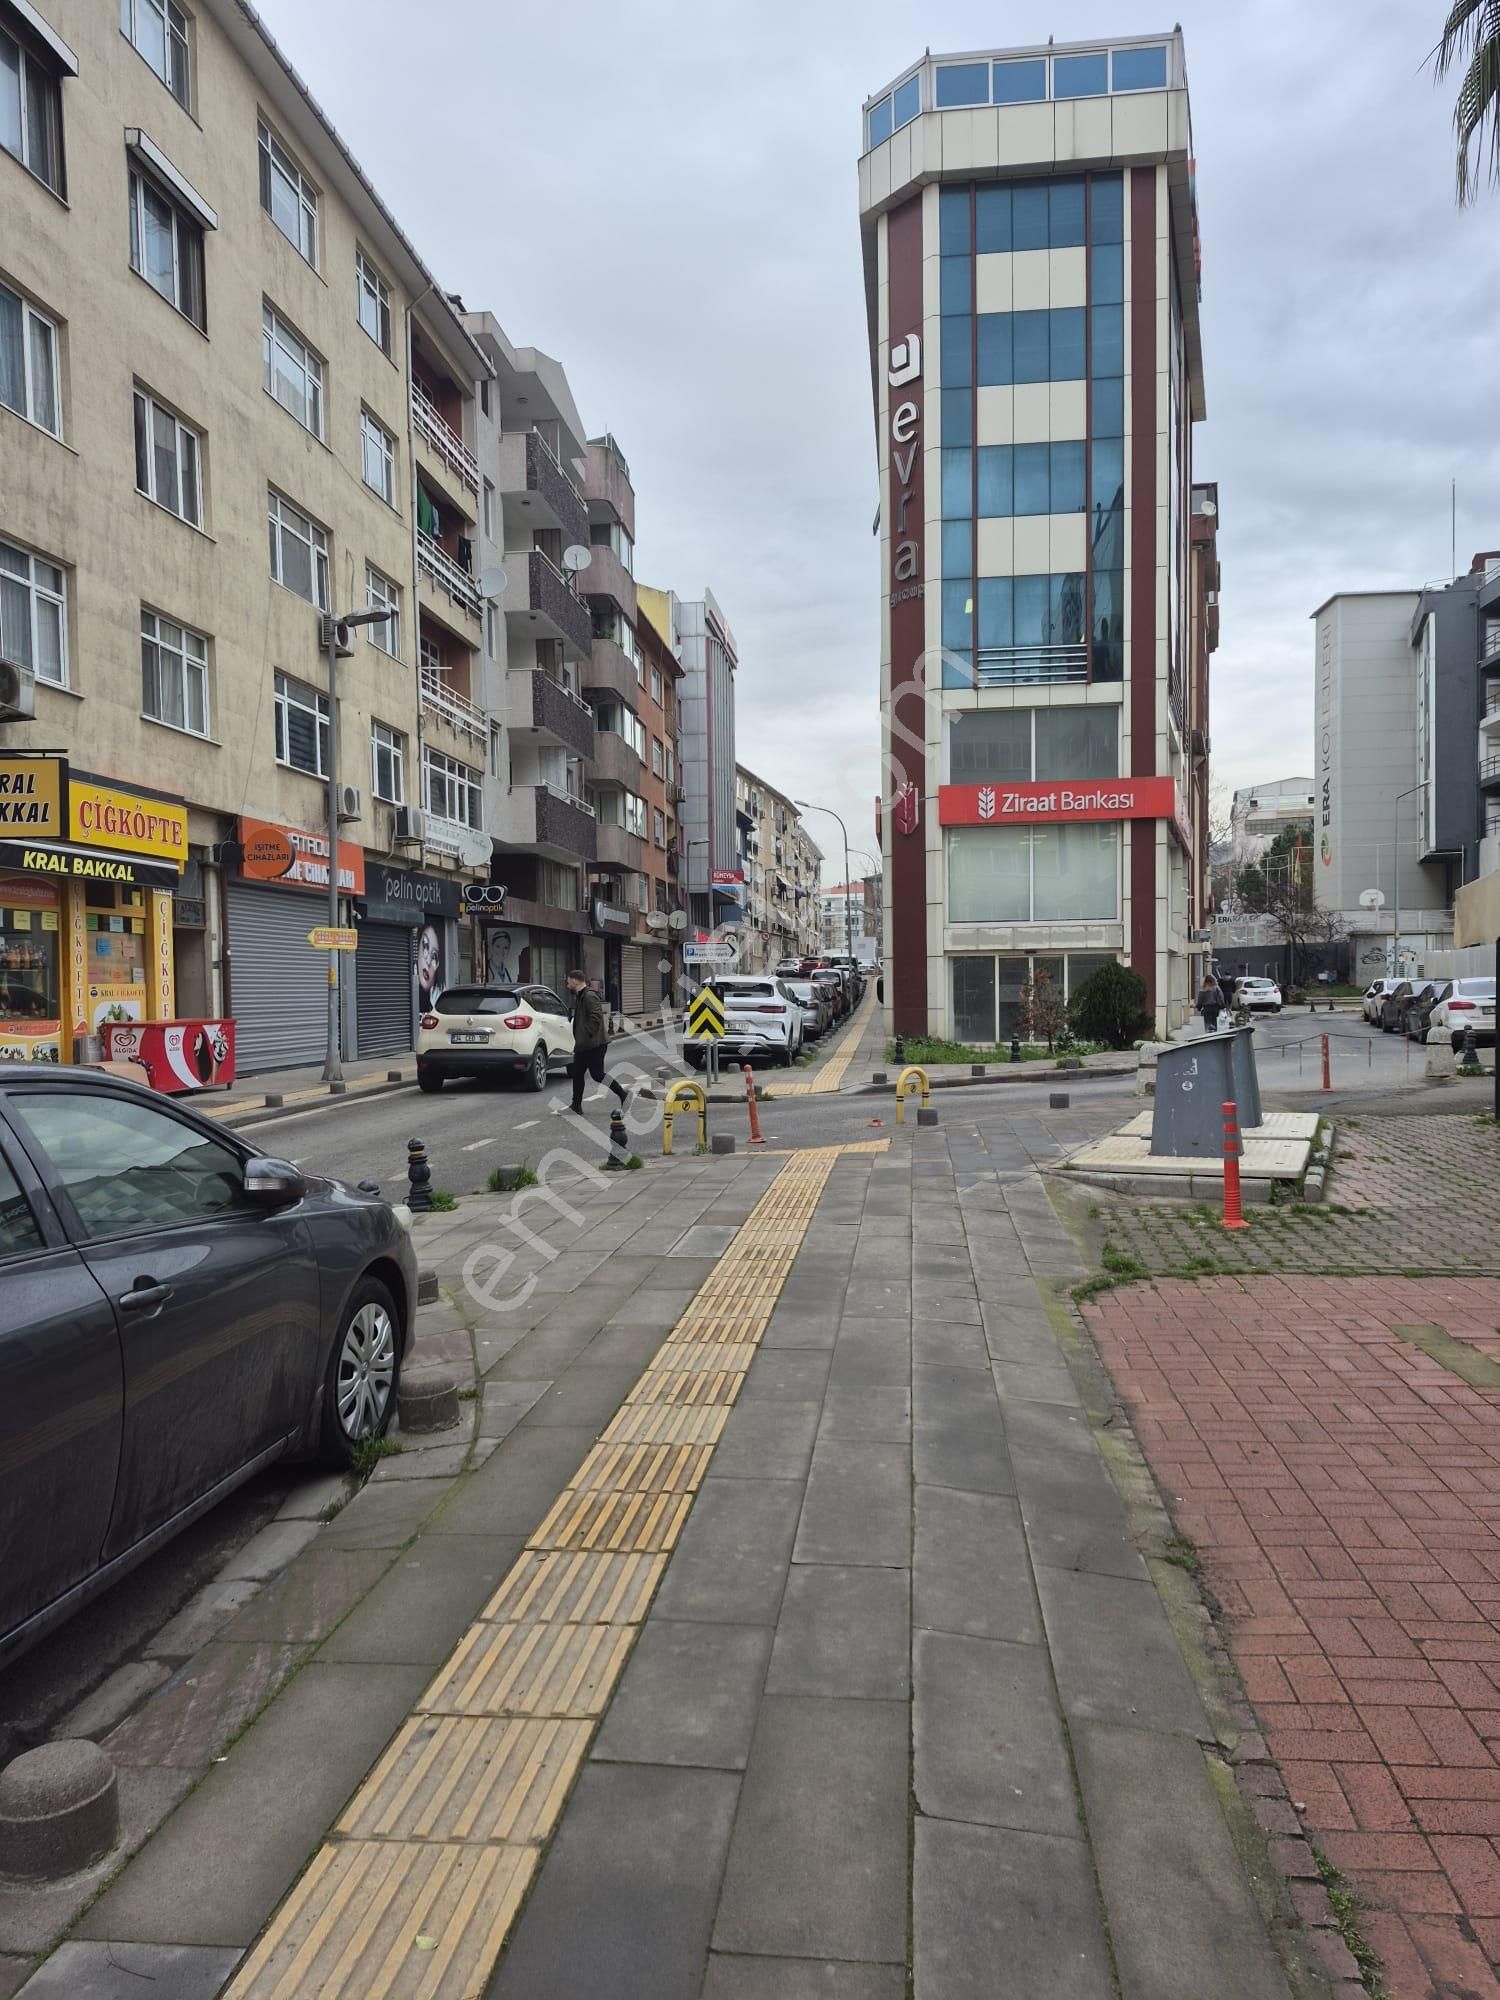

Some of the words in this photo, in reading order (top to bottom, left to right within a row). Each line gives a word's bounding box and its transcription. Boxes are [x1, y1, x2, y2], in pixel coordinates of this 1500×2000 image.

[1001, 792, 1057, 813] Ziraat
[1060, 790, 1134, 811] Bankası
[1322, 778, 1331, 827] ERA
[79, 793, 183, 847] ÇİĞKÖFTE
[23, 850, 69, 873] KRAL
[73, 857, 135, 881] BAKKAL
[385, 874, 413, 903] pelin
[415, 880, 442, 909] optik
